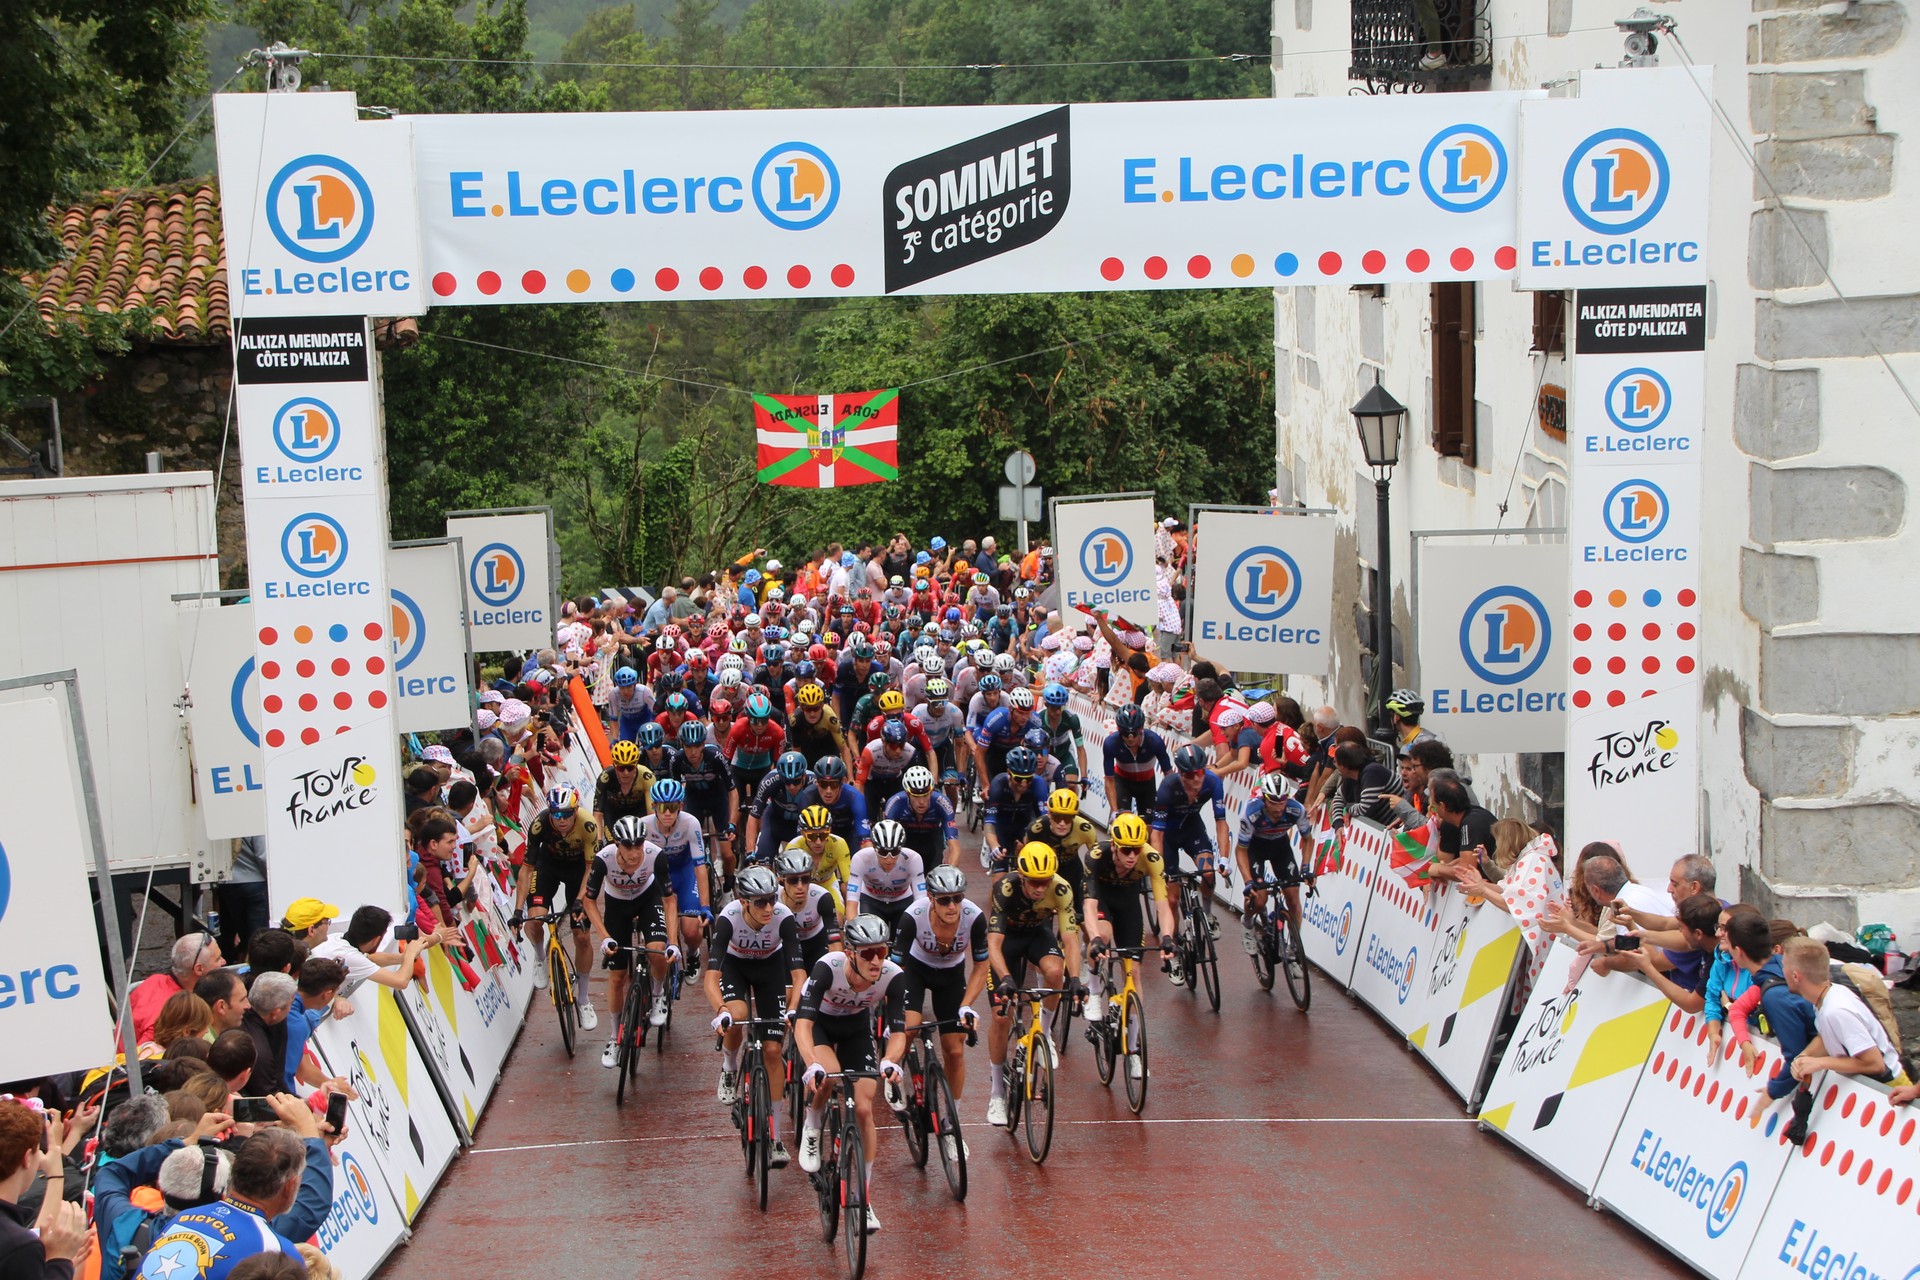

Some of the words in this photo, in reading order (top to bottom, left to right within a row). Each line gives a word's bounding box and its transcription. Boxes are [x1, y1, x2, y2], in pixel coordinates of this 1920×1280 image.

[895, 133, 1058, 230] SOMMET
[1123, 154, 1410, 203] E.Leclerc
[449, 169, 743, 217] E.Leclerc
[930, 188, 1053, 253] catégorie
[1531, 239, 1698, 267] E.Leclerc
[241, 267, 410, 295] E.Leclerc
[1581, 304, 1626, 320] ALKIZA
[1629, 302, 1702, 319] MENDATEA
[1595, 320, 1625, 337] CÔTE
[1628, 321, 1687, 336] D'ALKIZA
[240, 335, 285, 350] ALKIZA
[289, 332, 363, 348] MENDATEA
[256, 350, 288, 368] CÔTE
[290, 351, 350, 367] D'ALKIZA
[1585, 435, 1690, 452] E.Leclerc
[256, 465, 363, 484] E.Leclerc
[1584, 546, 1687, 562] E.Leclerc
[265, 580, 371, 599] E.Leclerc
[1067, 588, 1151, 607] ELeclerc
[1202, 620, 1321, 645] E.Leclerc
[755, 774, 780, 803] youfone
[738, 939, 771, 949] UAE
[1366, 933, 1402, 986] E.Leclerc
[831, 996, 871, 1008] UAE
[1630, 1128, 1715, 1209] E.Leclerc
[233, 1200, 256, 1213] STATE
[178, 1214, 236, 1242] BICYCLE
[317, 1189, 360, 1255] eclerc
[167, 1233, 195, 1241] BATTLE
[193, 1237, 207, 1255] BORN
